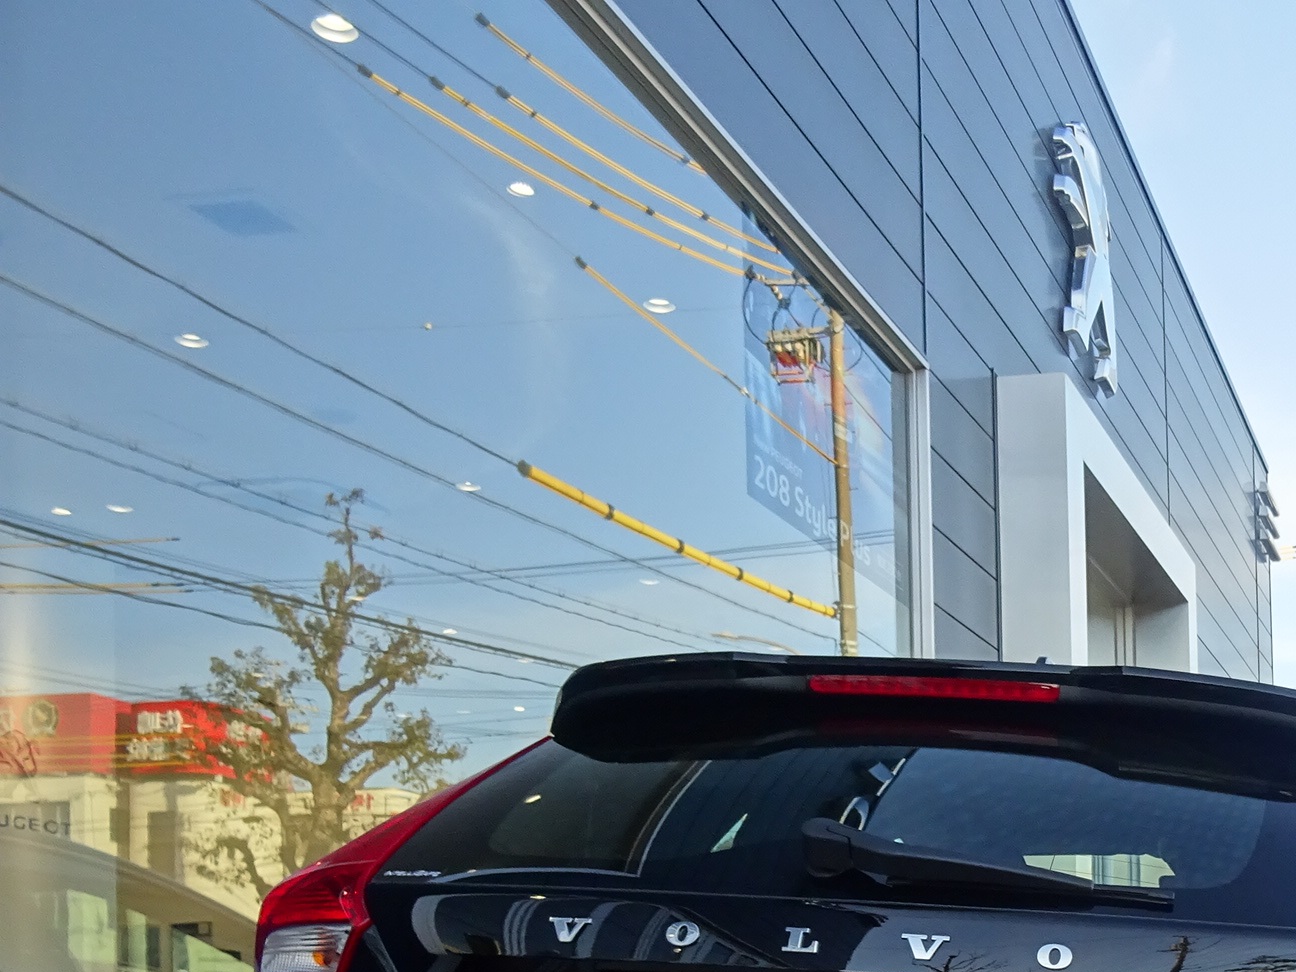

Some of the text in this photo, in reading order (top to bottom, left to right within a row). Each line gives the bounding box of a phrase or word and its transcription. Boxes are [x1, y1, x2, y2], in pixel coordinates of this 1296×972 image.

[754, 454, 790, 508] 208
[794, 486, 838, 542] Style
[548, 916, 1073, 971] VOLVO
